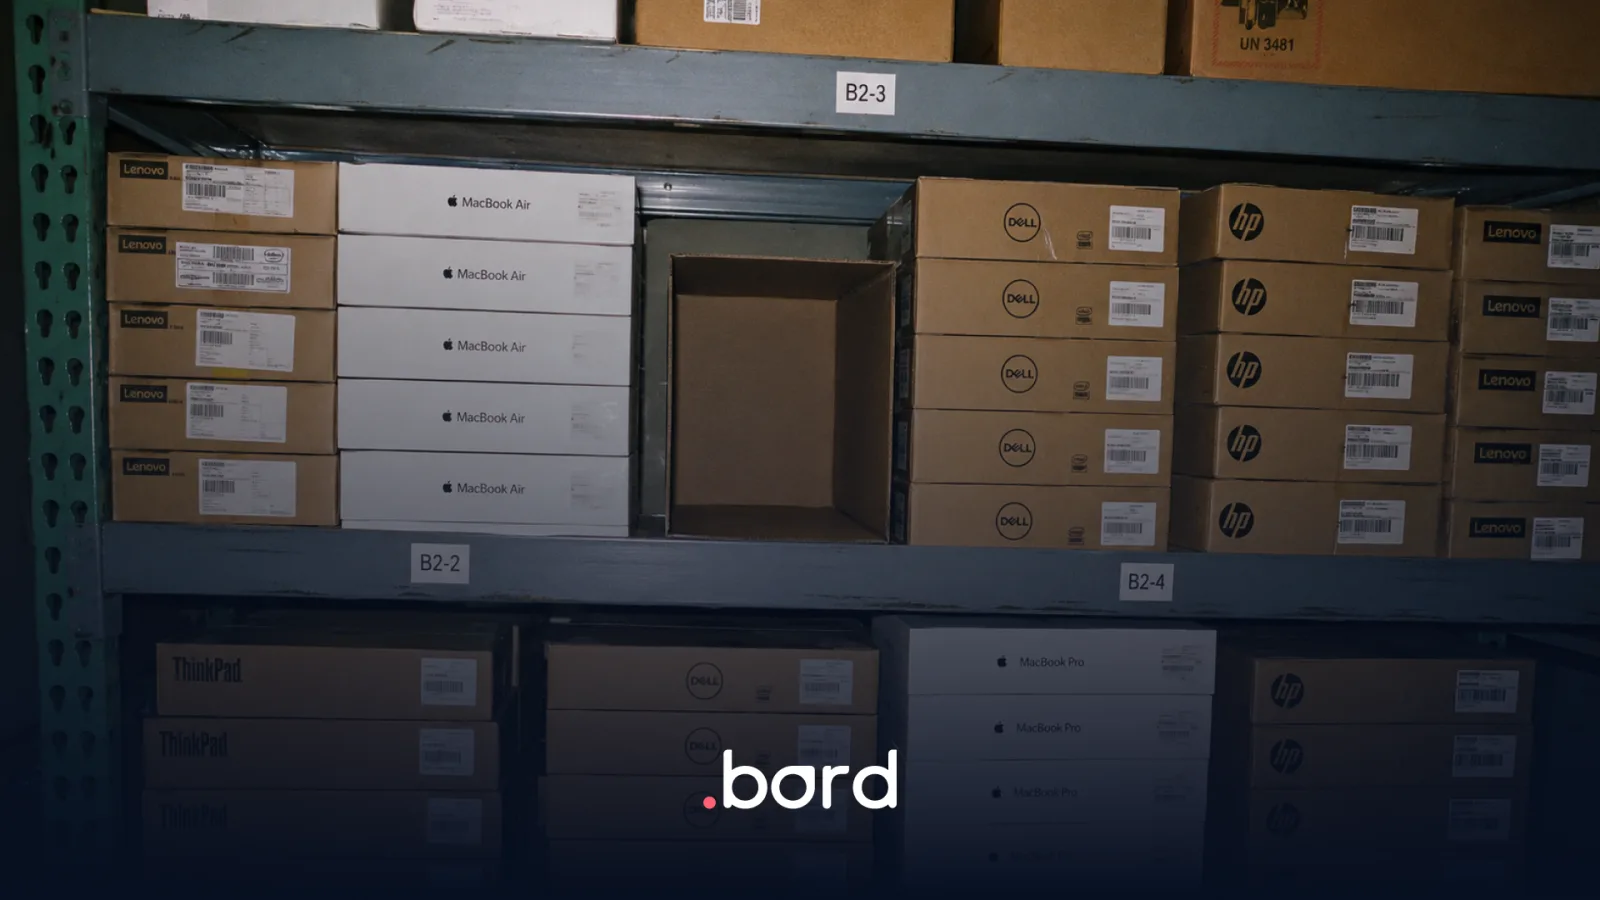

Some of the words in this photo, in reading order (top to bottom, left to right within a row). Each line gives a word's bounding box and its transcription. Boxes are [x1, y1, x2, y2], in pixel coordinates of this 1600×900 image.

[1239, 37, 1260, 51] UN
[1263, 38, 1295, 52] 3481
[846, 83, 886, 102] B2-3
[124, 164, 165, 176] Lenovo
[461, 196, 513, 210] MacBook
[515, 199, 532, 211] Air
[1008, 217, 1037, 228] DELL
[1231, 203, 1262, 242] hp
[1488, 225, 1538, 241] Lenovo
[122, 239, 163, 251] Lenovo
[457, 269, 508, 282] MacBook
[510, 271, 527, 282] Air
[1006, 293, 1036, 305] DELL
[1234, 278, 1265, 316] hp
[1487, 299, 1536, 314] Lenovo
[124, 314, 165, 326] Lenovo
[457, 340, 508, 353] MacBook
[510, 342, 527, 354] Air
[1005, 368, 1035, 380] DELL
[1229, 351, 1260, 389] hp
[1483, 373, 1531, 387] Lenovo
[123, 388, 164, 400] Lenovo
[456, 411, 508, 424] MacBook
[509, 413, 526, 425] Air
[1003, 442, 1032, 454] DELL
[1230, 424, 1260, 463] hp
[1479, 447, 1527, 461] Lenovo
[126, 461, 167, 473] Lenovo
[456, 482, 508, 495] MacBook
[509, 484, 526, 495] Air
[1000, 516, 1029, 527] DELL
[1222, 501, 1252, 539] hp
[1474, 521, 1522, 535] Lenovo
[421, 554, 460, 572] B2-2
[1129, 573, 1165, 590] B2-4
[172, 656, 243, 682] ThinkPad
[1019, 656, 1067, 668] MacBook
[1068, 656, 1085, 668] Pro
[691, 676, 719, 686] DELL
[1274, 673, 1301, 709] hp
[1016, 722, 1063, 733] MacBook
[1064, 722, 1082, 733] Pro
[159, 731, 229, 757] ThinkPad
